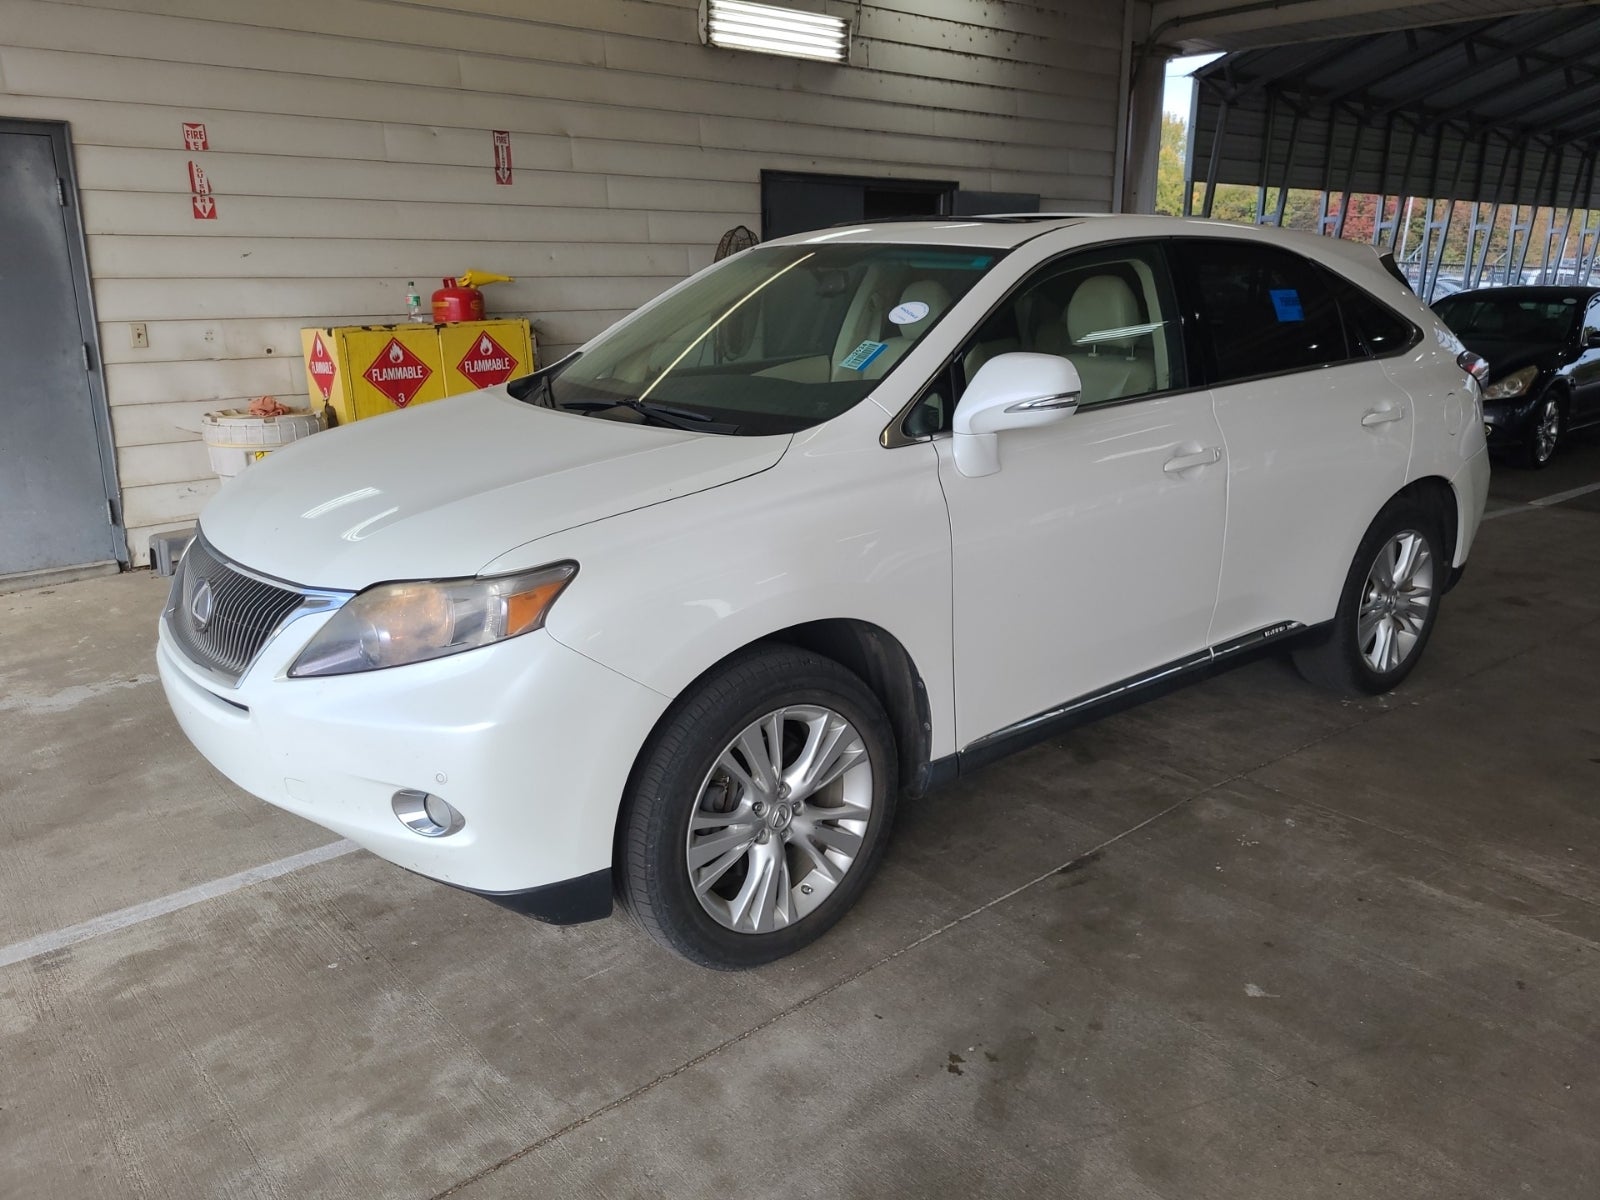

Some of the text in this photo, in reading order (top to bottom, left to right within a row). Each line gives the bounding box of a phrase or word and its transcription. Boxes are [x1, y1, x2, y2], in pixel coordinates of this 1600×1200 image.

[186, 130, 203, 139] FIRE
[464, 357, 511, 373] FLAMMABLE
[372, 366, 423, 381] FLAMMABLE
[398, 392, 406, 403] 3
